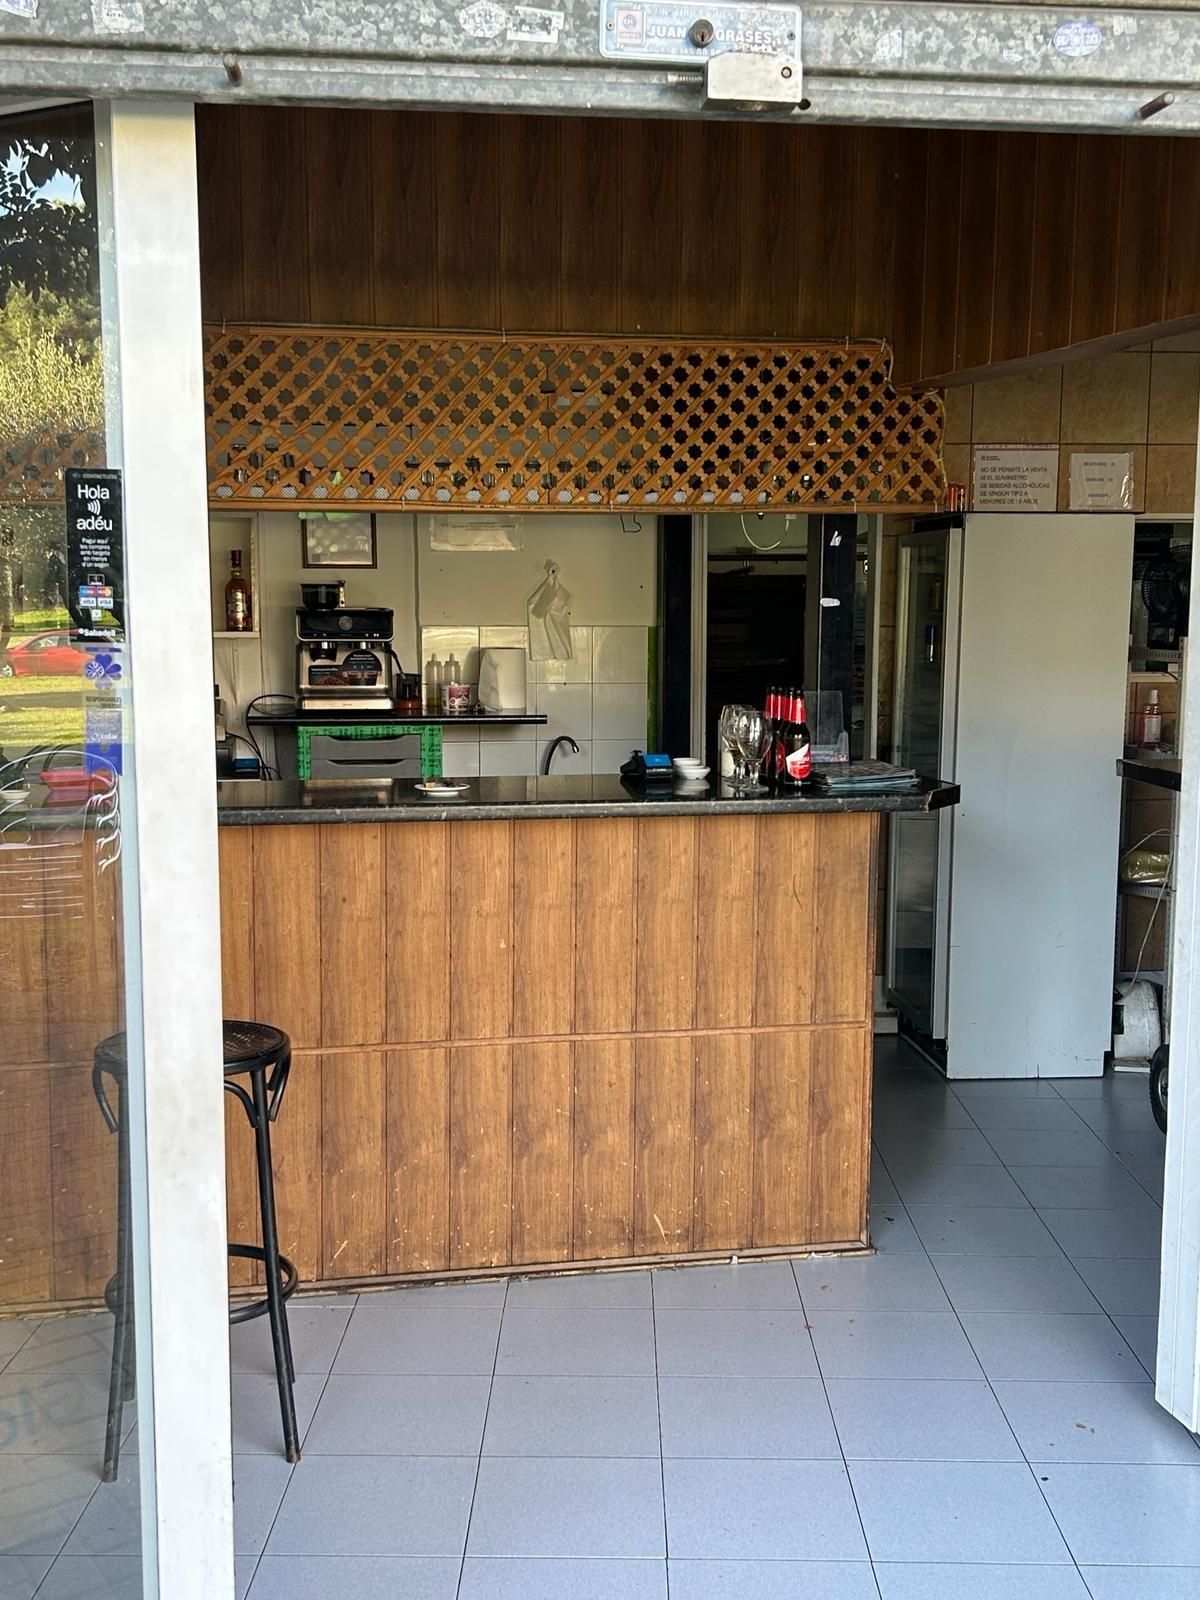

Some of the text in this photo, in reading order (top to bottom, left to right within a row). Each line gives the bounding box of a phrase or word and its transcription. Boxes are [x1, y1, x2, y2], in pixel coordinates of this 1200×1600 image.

[646, 24, 687, 40] JUAN
[77, 484, 110, 500] Hola
[76, 515, 113, 532] adéu
[84, 628, 116, 637] Sabadell
